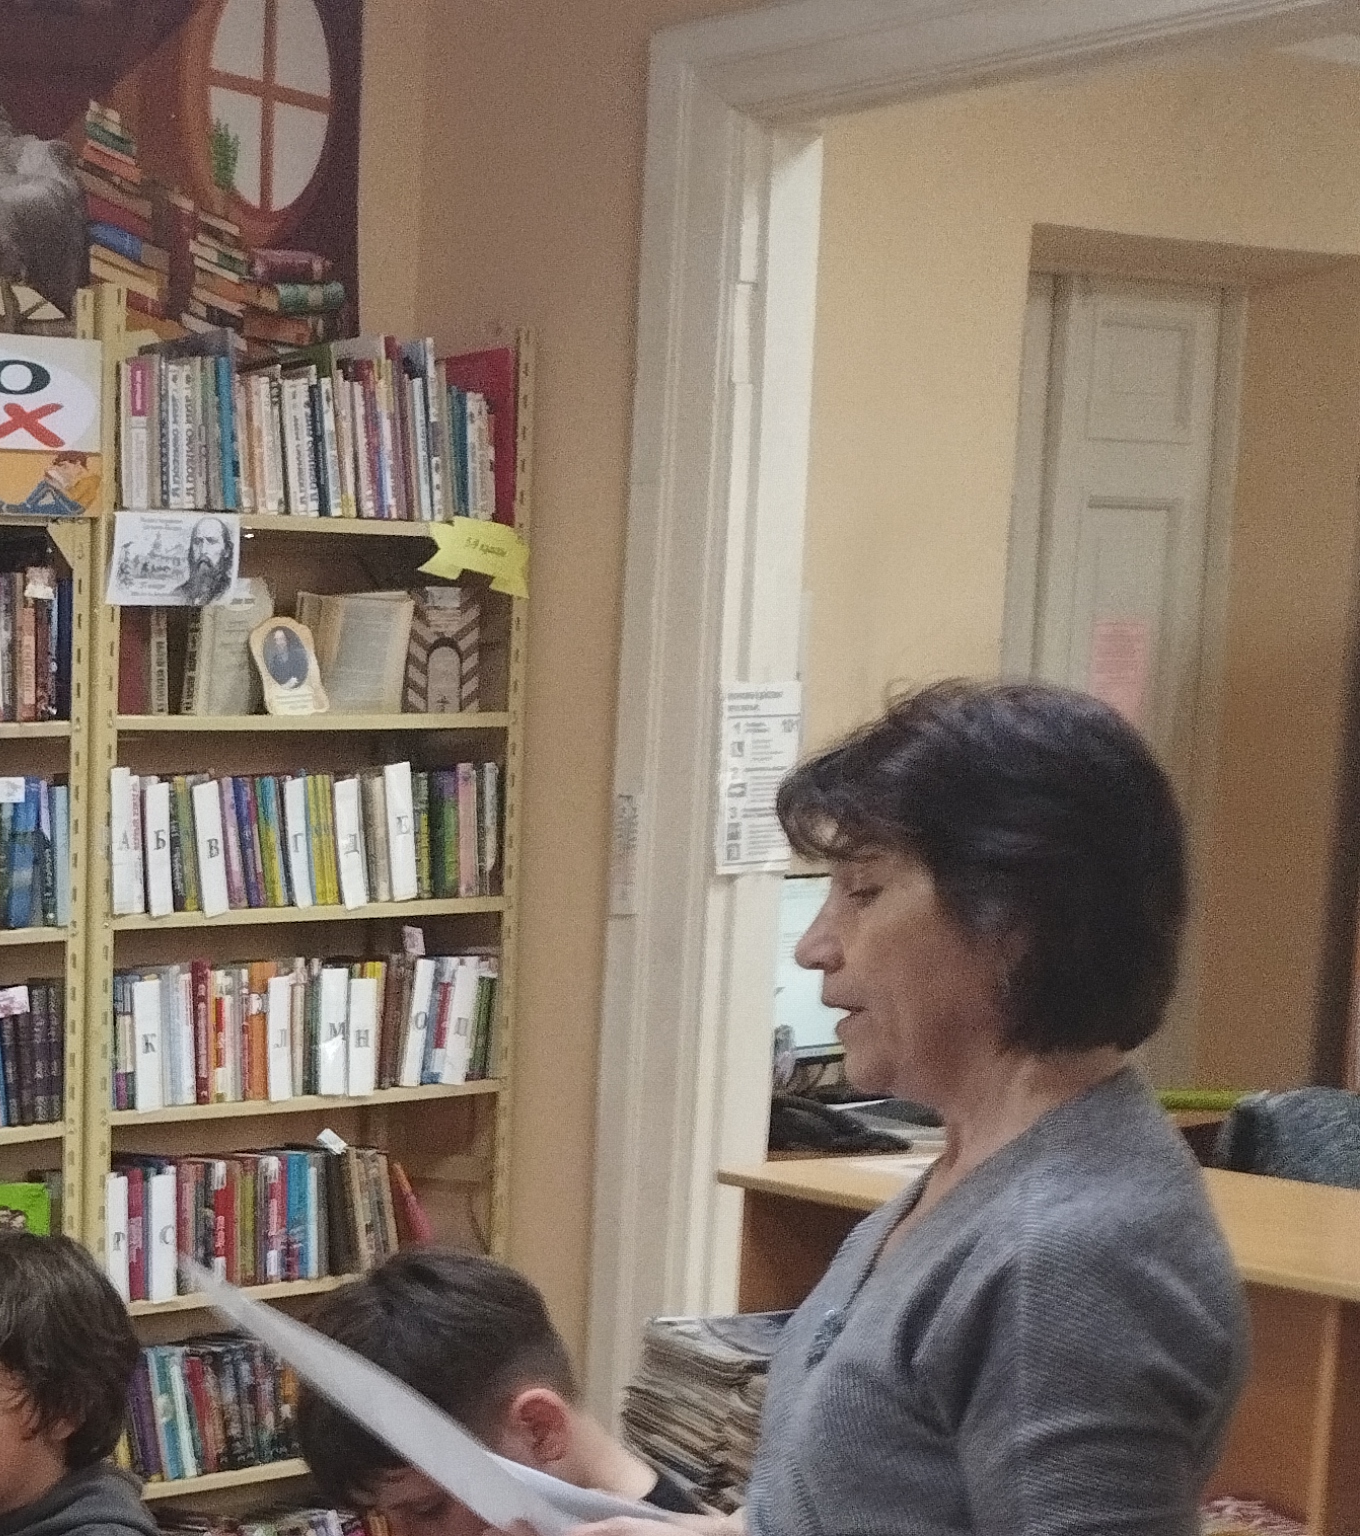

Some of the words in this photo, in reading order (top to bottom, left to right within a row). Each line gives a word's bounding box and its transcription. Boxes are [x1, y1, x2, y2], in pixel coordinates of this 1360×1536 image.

[153, 829, 167, 851] Б
[207, 838, 220, 859] В
[292, 832, 305, 853] Г
[413, 1011, 428, 1032] О
[142, 1033, 157, 1055] К
[355, 1028, 371, 1049] Н
